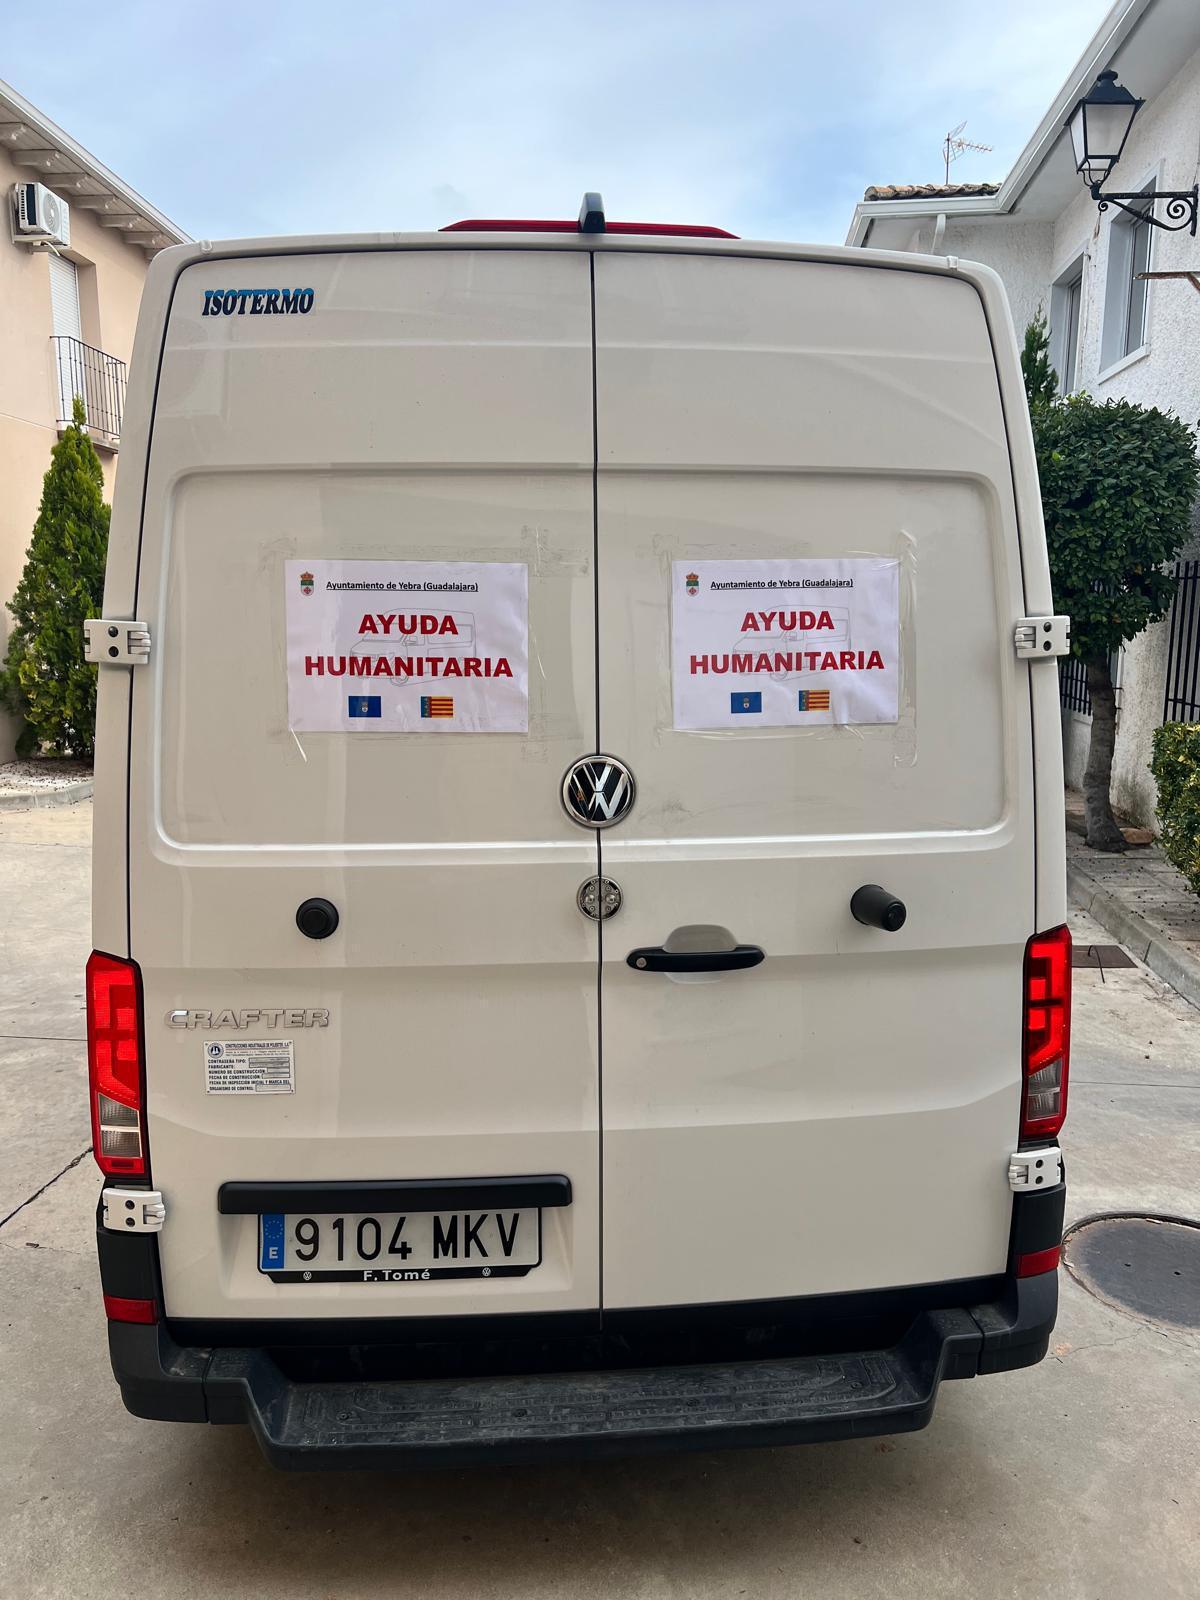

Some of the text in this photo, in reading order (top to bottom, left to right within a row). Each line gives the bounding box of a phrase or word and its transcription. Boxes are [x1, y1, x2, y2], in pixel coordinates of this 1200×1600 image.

[202, 287, 315, 316] ISOTERMO
[326, 581, 479, 592] Ayuntamiento de Yebra (Guadalajara)
[710, 578, 854, 590] Ayuntamiento de Yebra (Guadalajara)
[358, 614, 459, 635] AYUDA
[740, 610, 835, 632] AYUDA
[305, 655, 514, 678] HUMANITARIA
[690, 650, 885, 675] HUMANITARIA
[165, 1008, 330, 1030] CRAFTER
[294, 1213, 520, 1262] 9104 MKV
[268, 1246, 279, 1259] E
[363, 1269, 431, 1281] F. Tomé
